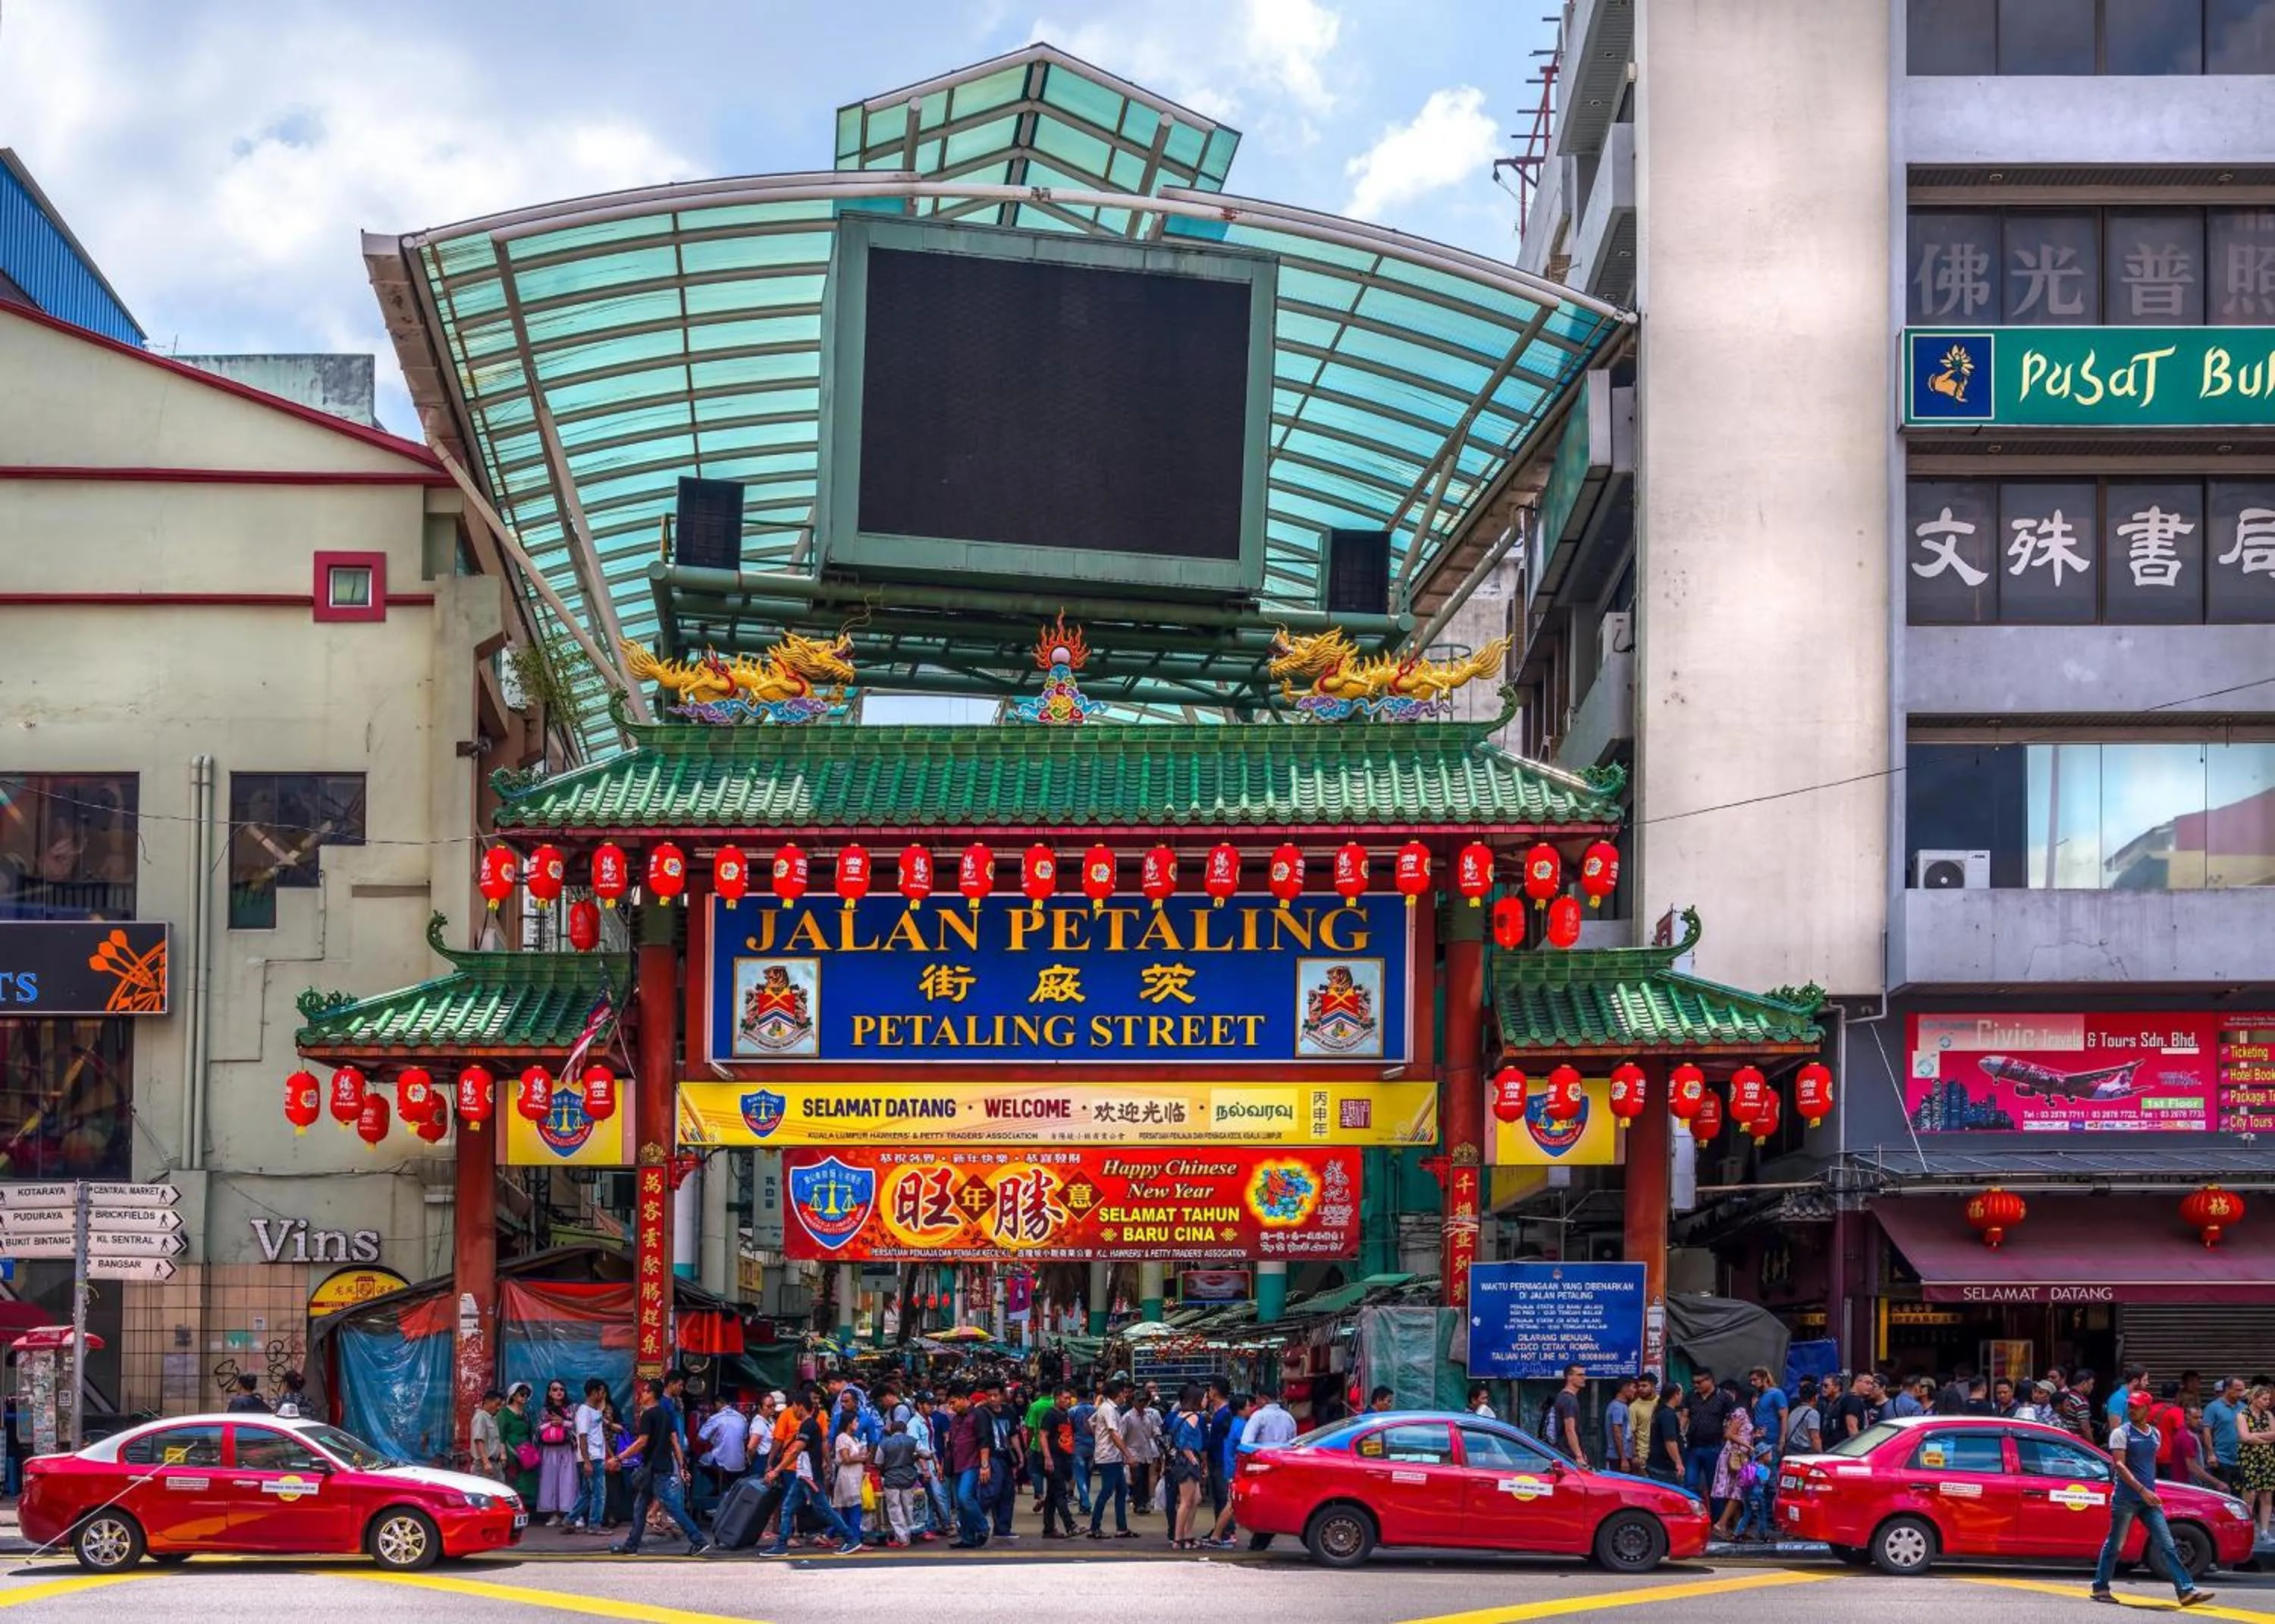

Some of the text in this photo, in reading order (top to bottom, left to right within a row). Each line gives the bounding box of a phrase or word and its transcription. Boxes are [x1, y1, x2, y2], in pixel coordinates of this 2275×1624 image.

[2199, 346, 2275, 400] Bu
[745, 908, 1371, 952] JALAN PETALING
[850, 1014, 1077, 1048] PETALING
[1090, 1014, 1265, 1048] STREET
[1977, 1019, 2035, 1049] Civic
[2087, 1033, 2097, 1048] &
[2100, 1032, 2136, 1048] Tours
[2141, 1031, 2168, 1048] Sdn.
[2171, 1031, 2199, 1048] Bhd.
[2230, 1046, 2269, 1061] Ticketing
[2230, 1068, 2252, 1080] Hotel
[2230, 1089, 2267, 1105] Package
[802, 1098, 1071, 1118] SELAMAT DATANG WELCOME
[1094, 1100, 1186, 1124] 欢迎光临
[1313, 1091, 1328, 1138] 丙申年
[2230, 1115, 2273, 1130] City Tours
[1102, 1158, 1238, 1179] Happy Chinese
[17, 1187, 66, 1196] KOTARAYA
[129, 1187, 159, 1196] MARKET
[1126, 1183, 1214, 1199] New Year
[13, 1212, 63, 1220] PUDURAYA
[95, 1212, 155, 1220] BRICKFIELDS
[1099, 1207, 1240, 1222] SELAMAT TAHUN
[5, 1237, 71, 1246] BUKIT BINTANG
[111, 1236, 154, 1245] SENTRAL
[250, 1218, 380, 1263] Vins
[1123, 1227, 1216, 1242] BARU CINA
[98, 1259, 142, 1268] BANGSAR
[1481, 1282, 1508, 1290] WAKTU
[1562, 1282, 1583, 1290] YANG
[1963, 1287, 2113, 1300] SELAMAT DATANG
[1569, 1343, 1599, 1351] ROMPAK
[1492, 1353, 1517, 1361] TALIAN
[1520, 1353, 1536, 1361] HOT
[1539, 1353, 1555, 1361] LINE
